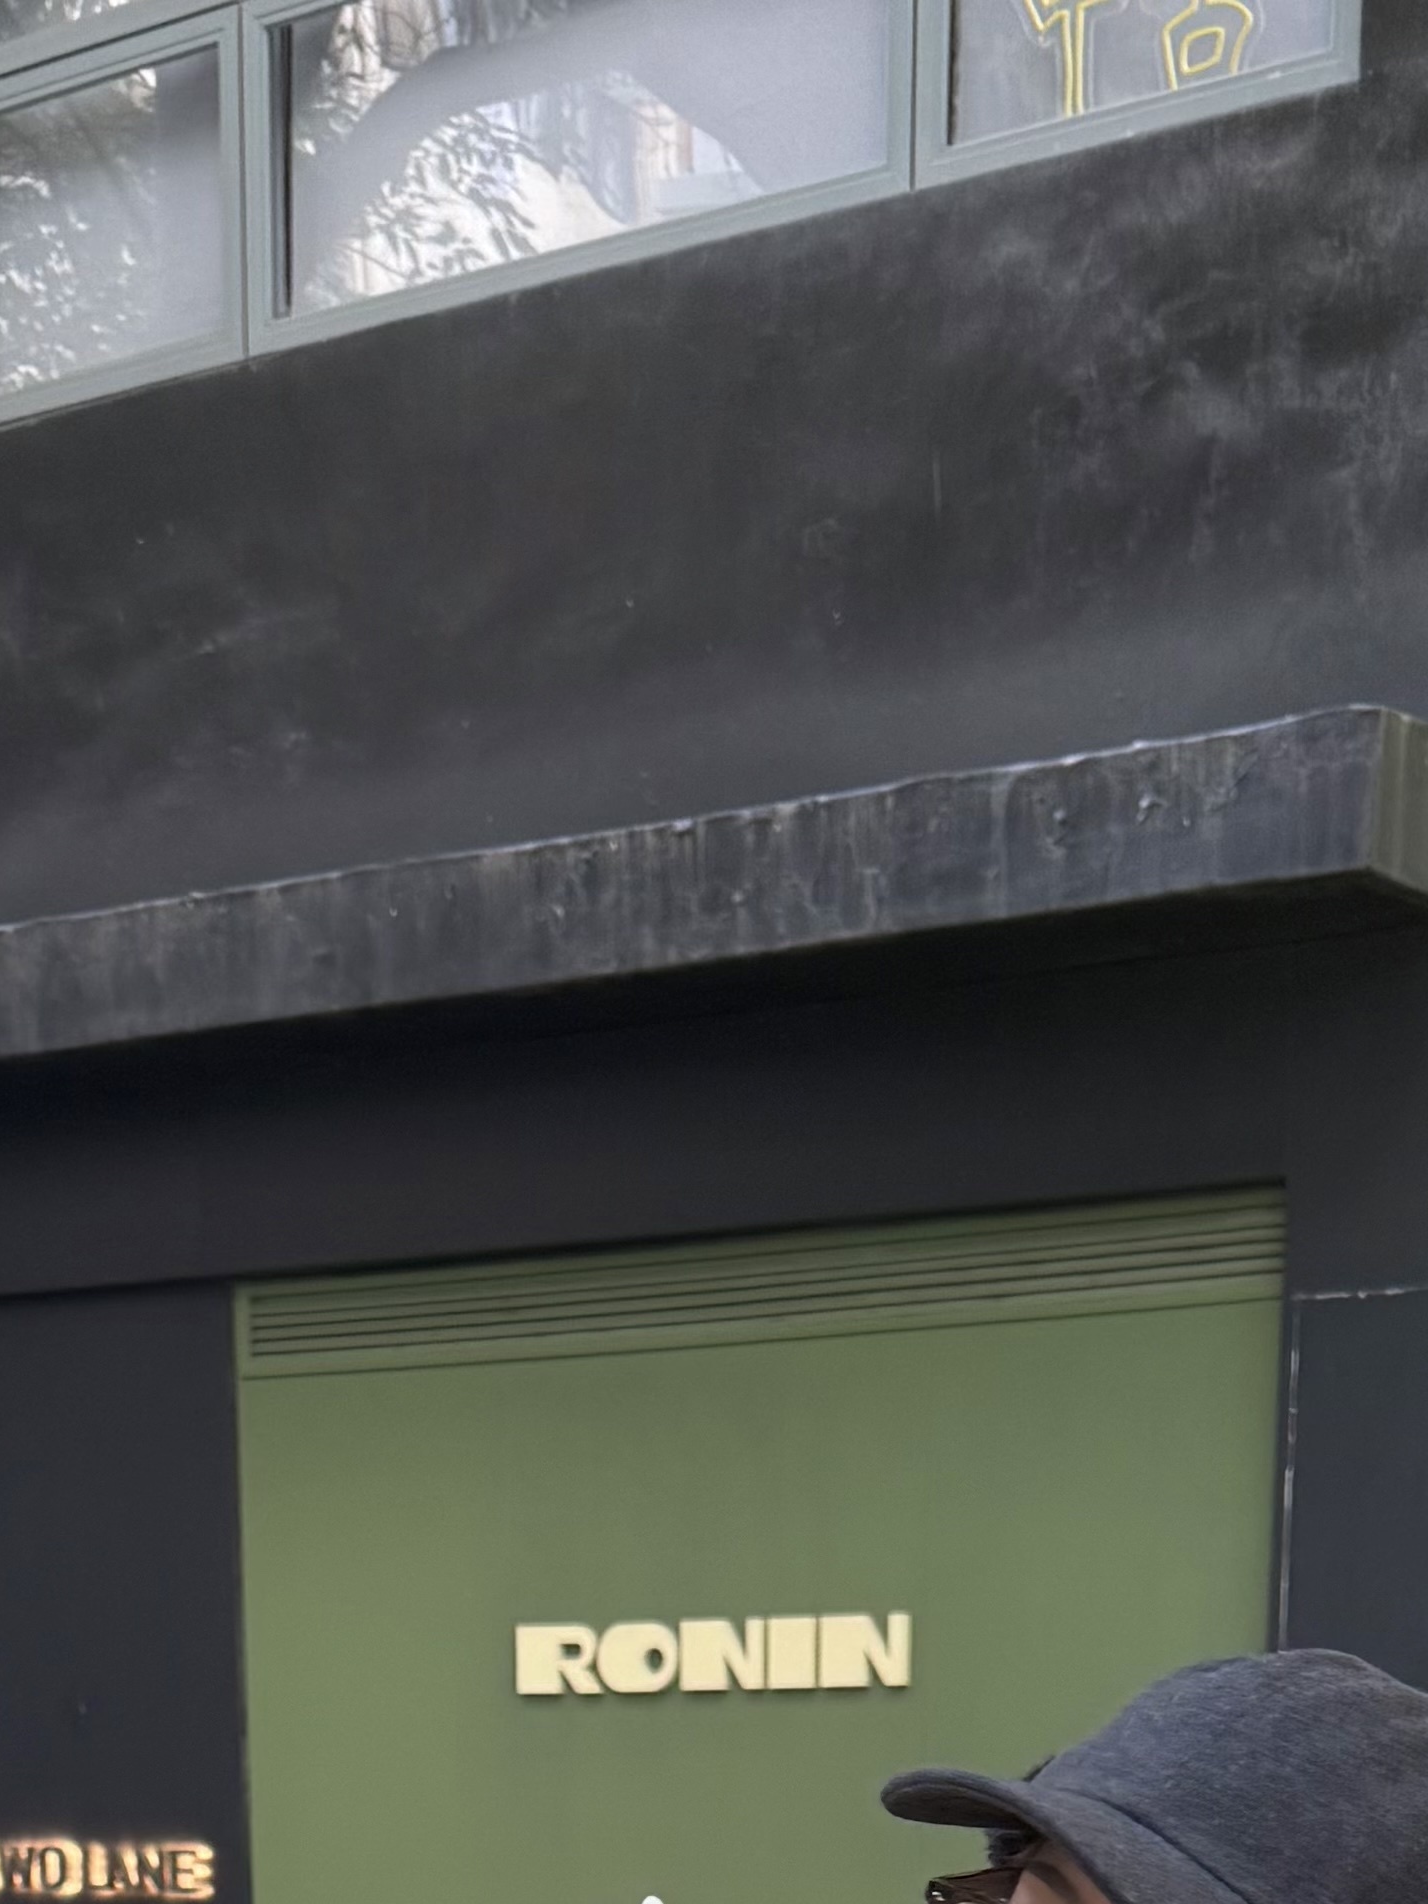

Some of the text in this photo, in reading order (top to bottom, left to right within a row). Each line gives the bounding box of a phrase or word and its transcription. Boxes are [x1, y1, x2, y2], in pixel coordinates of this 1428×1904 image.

[514, 1611, 913, 1696] RONIN
[0, 1843, 69, 1892] WO
[80, 1844, 206, 1895] LANE
